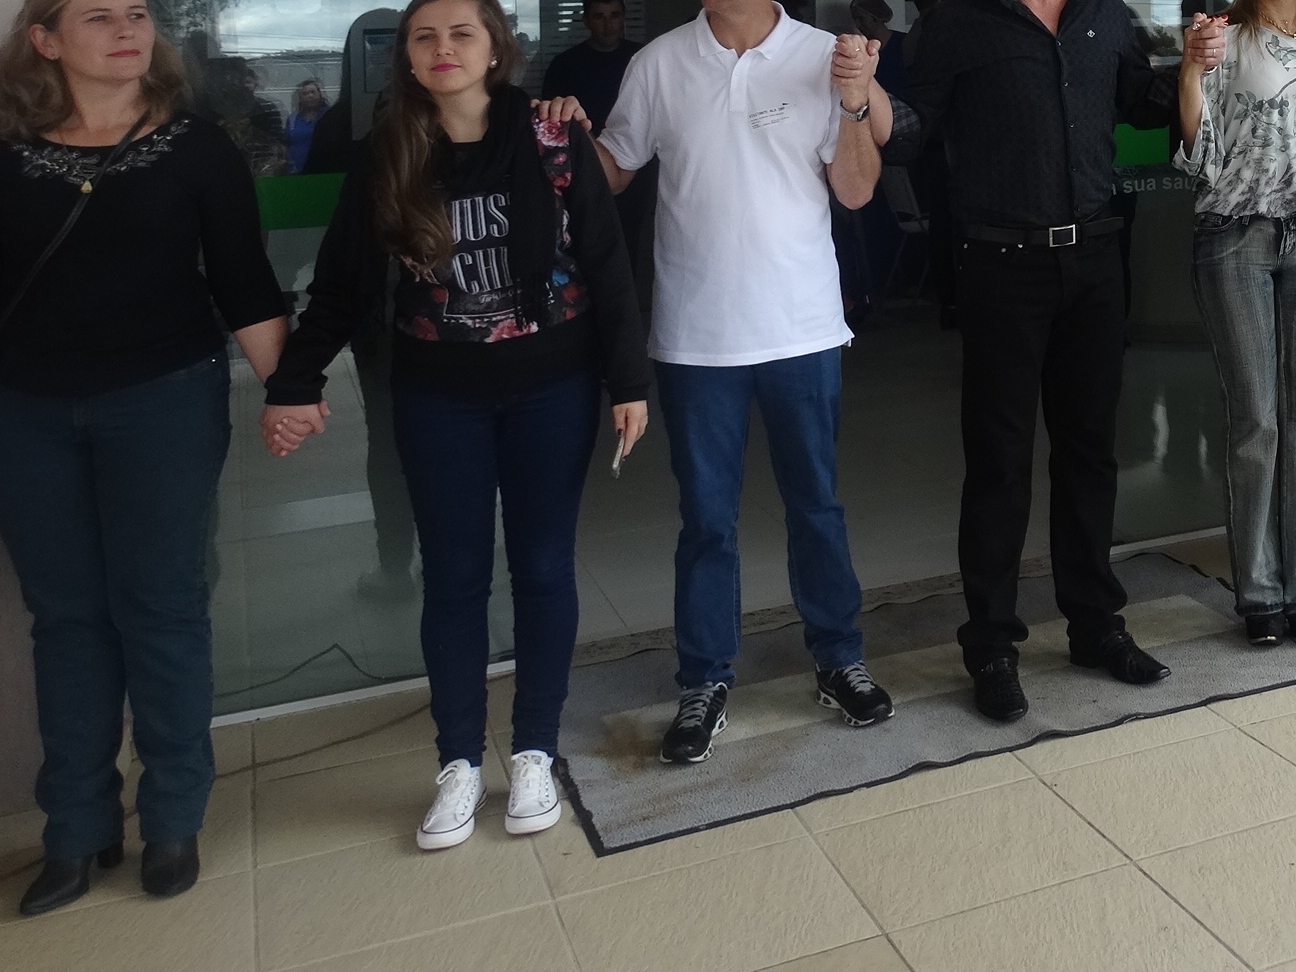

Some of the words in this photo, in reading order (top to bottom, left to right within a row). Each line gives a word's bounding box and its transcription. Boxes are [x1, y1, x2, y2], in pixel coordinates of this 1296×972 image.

[1122, 177, 1157, 194] sua
[1161, 175, 1193, 190] sau
[451, 192, 511, 245] JUS
